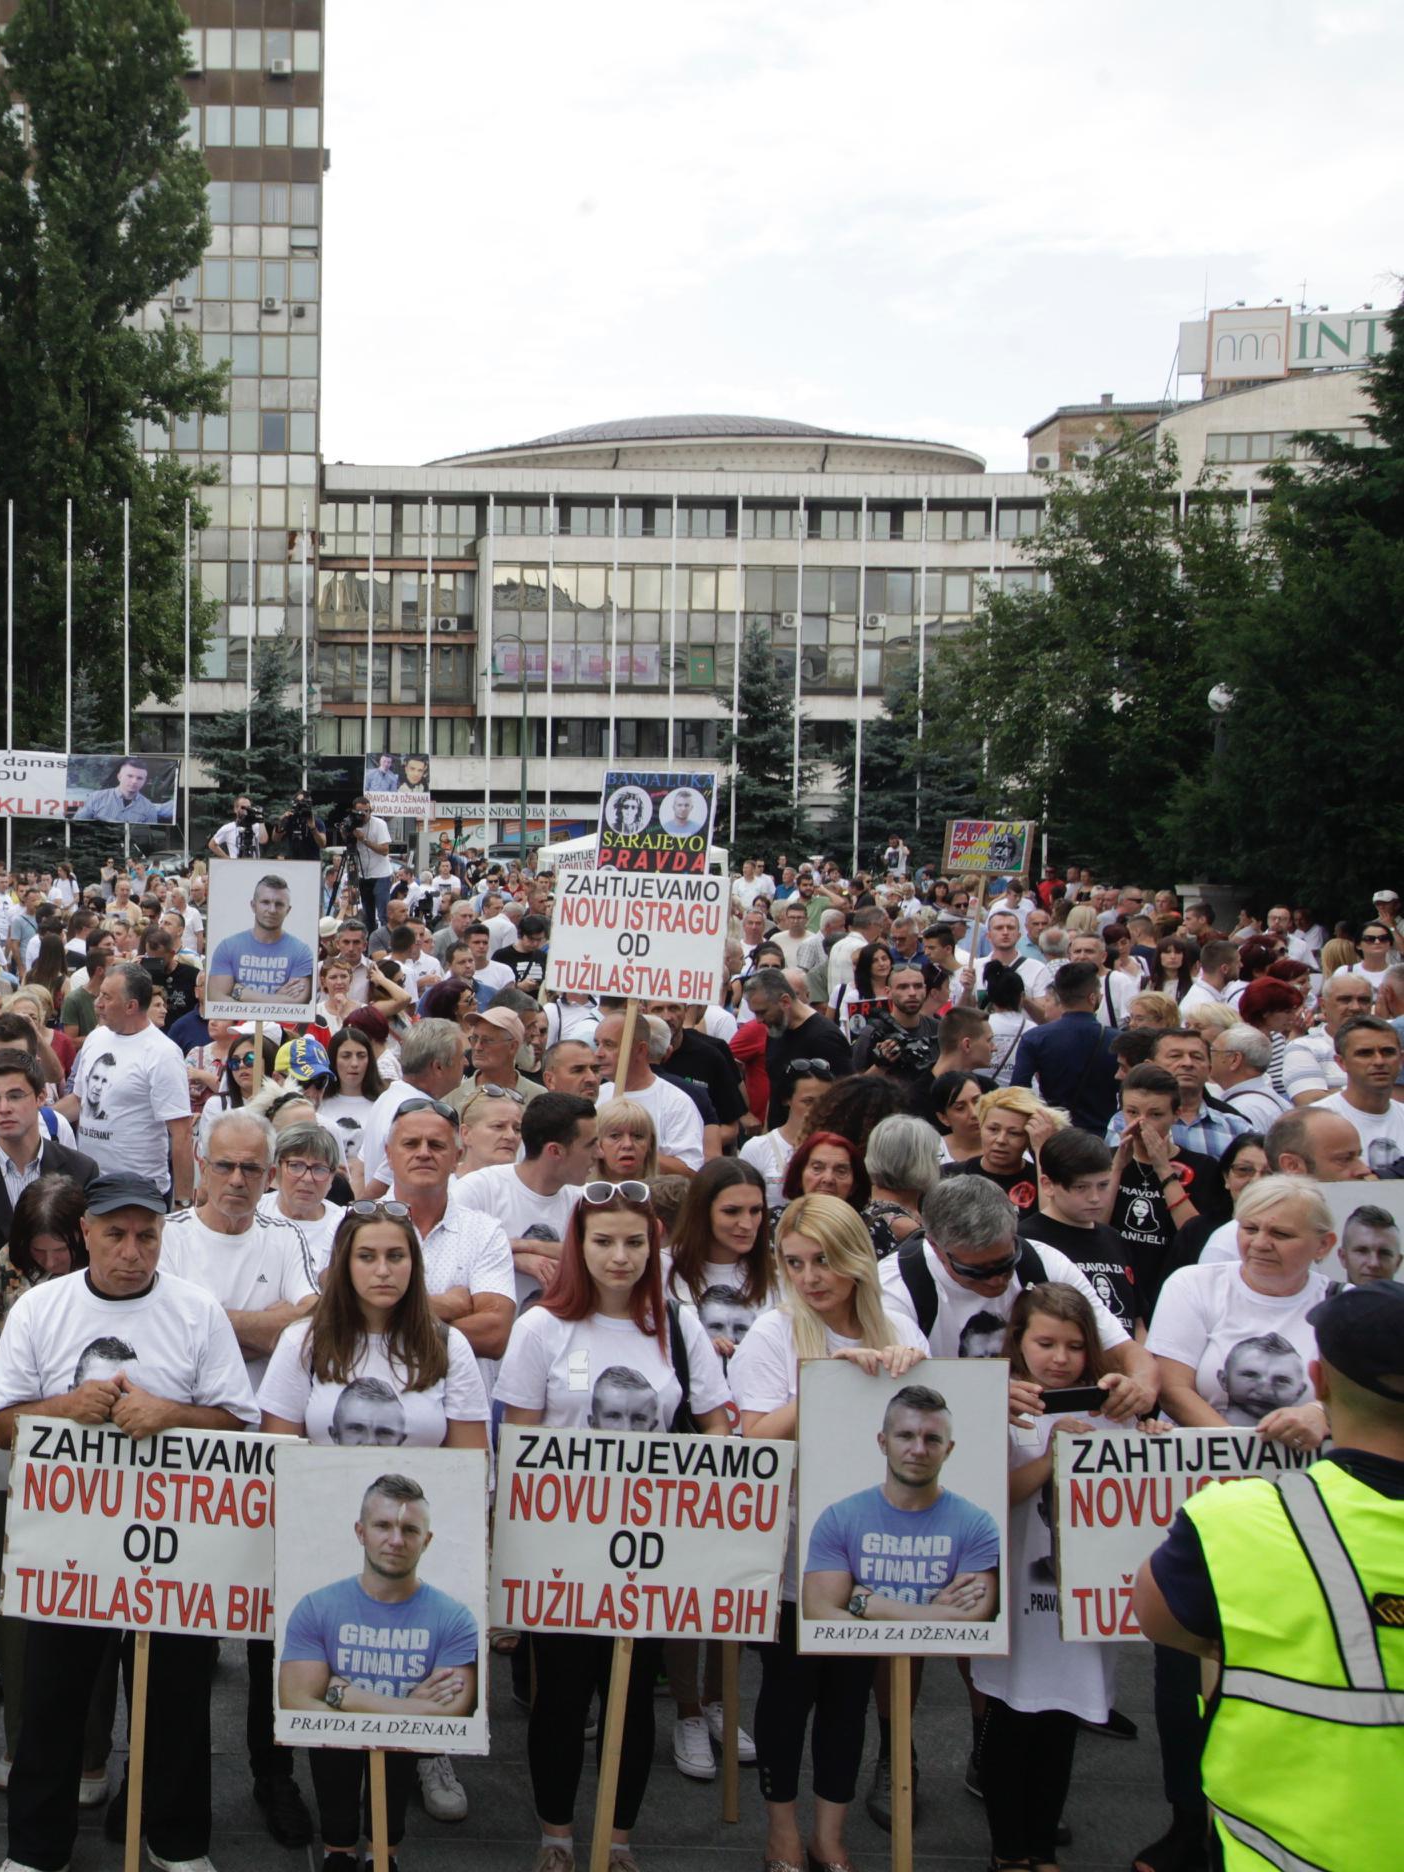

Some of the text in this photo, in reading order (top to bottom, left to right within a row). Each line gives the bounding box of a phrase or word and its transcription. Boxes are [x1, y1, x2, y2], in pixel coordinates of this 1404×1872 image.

[3, 756, 67, 769] danas
[606, 773, 714, 788] BANJA LUKA
[602, 830, 705, 852] SARAJEVO
[955, 832, 968, 842] ZA
[597, 849, 707, 873] PRAVDA
[994, 846, 1008, 856] ZA
[564, 874, 720, 902] ZAHTIJEVAMO
[560, 897, 721, 936] NOVU ISTRAGU
[617, 932, 651, 957] OD
[239, 954, 289, 969] GRAND
[238, 967, 287, 984] FINALS
[554, 954, 714, 1001] TUŽILAŠTVA BIH
[212, 1005, 306, 1015] PRAVDA ZA DŽENANA
[1119, 1185, 1161, 1199] RAVDA
[515, 1435, 779, 1480] ZAHTIJEVAMO
[23, 1462, 275, 1529] NOVU ISTRAG
[509, 1472, 779, 1532] NOVU ISTRAGU
[1070, 1477, 1172, 1528] NOVU
[123, 1523, 178, 1564] OD
[609, 1530, 664, 1569] OD
[861, 1533, 952, 1557] GRAND
[859, 1557, 948, 1584] FINALS
[16, 1559, 217, 1629] TUŽILAŠTVA
[502, 1568, 768, 1635] TUŽILAŠTVA BIH
[1071, 1574, 1141, 1636] TUŽ
[338, 1623, 430, 1650] GRAND
[813, 1625, 990, 1642] PRAVDA ZA DŽENANA
[337, 1648, 426, 1678] FINALS
[289, 1717, 468, 1737] PRAVDA ZA DŽENANA
